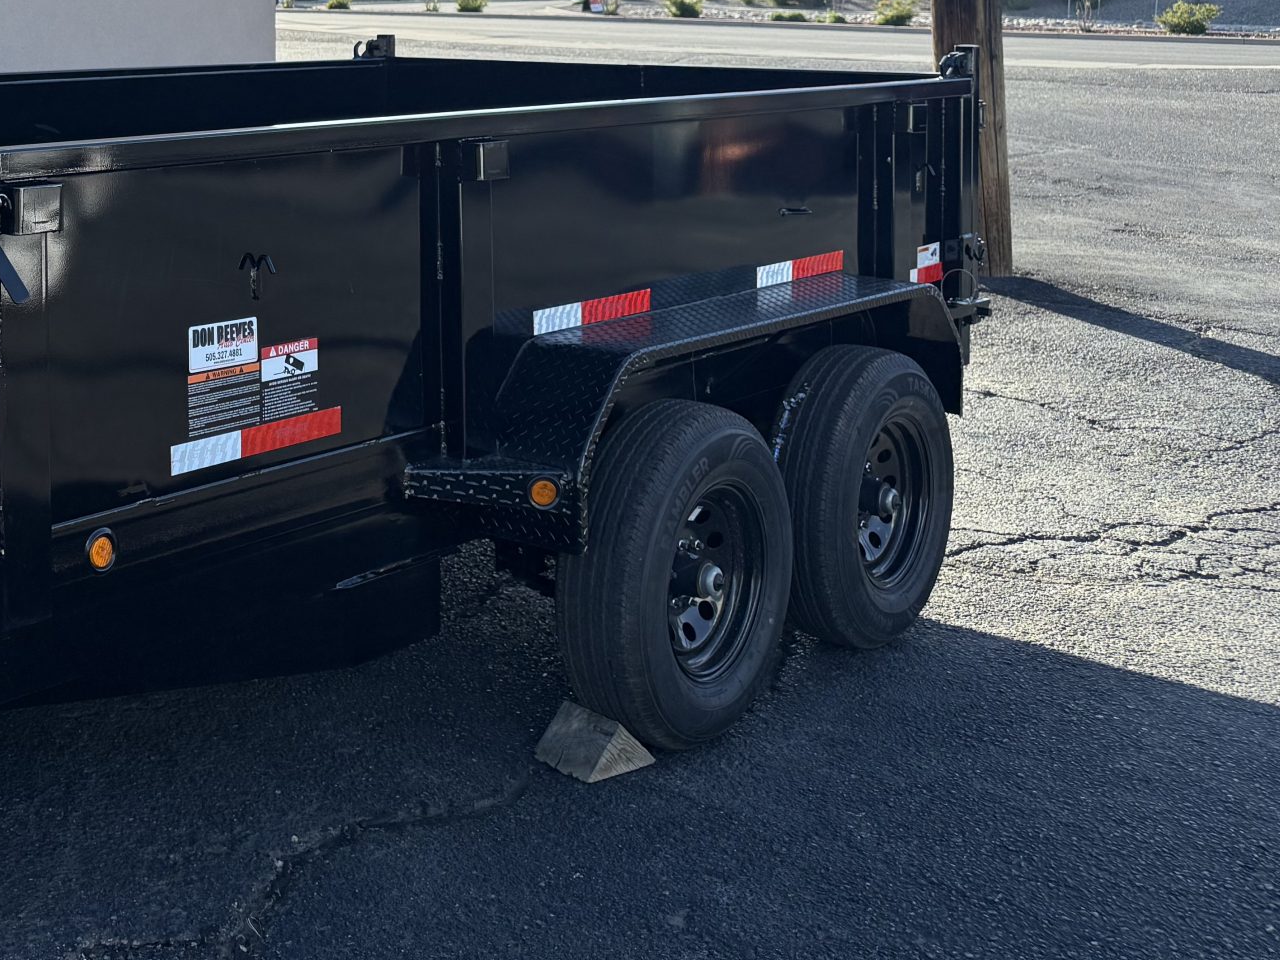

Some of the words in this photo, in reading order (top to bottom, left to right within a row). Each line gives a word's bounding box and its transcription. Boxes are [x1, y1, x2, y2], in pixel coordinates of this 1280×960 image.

[192, 326, 215, 349] DON
[216, 320, 255, 345] REEVES
[278, 340, 310, 355] DANGER
[211, 368, 237, 378] WARNING
